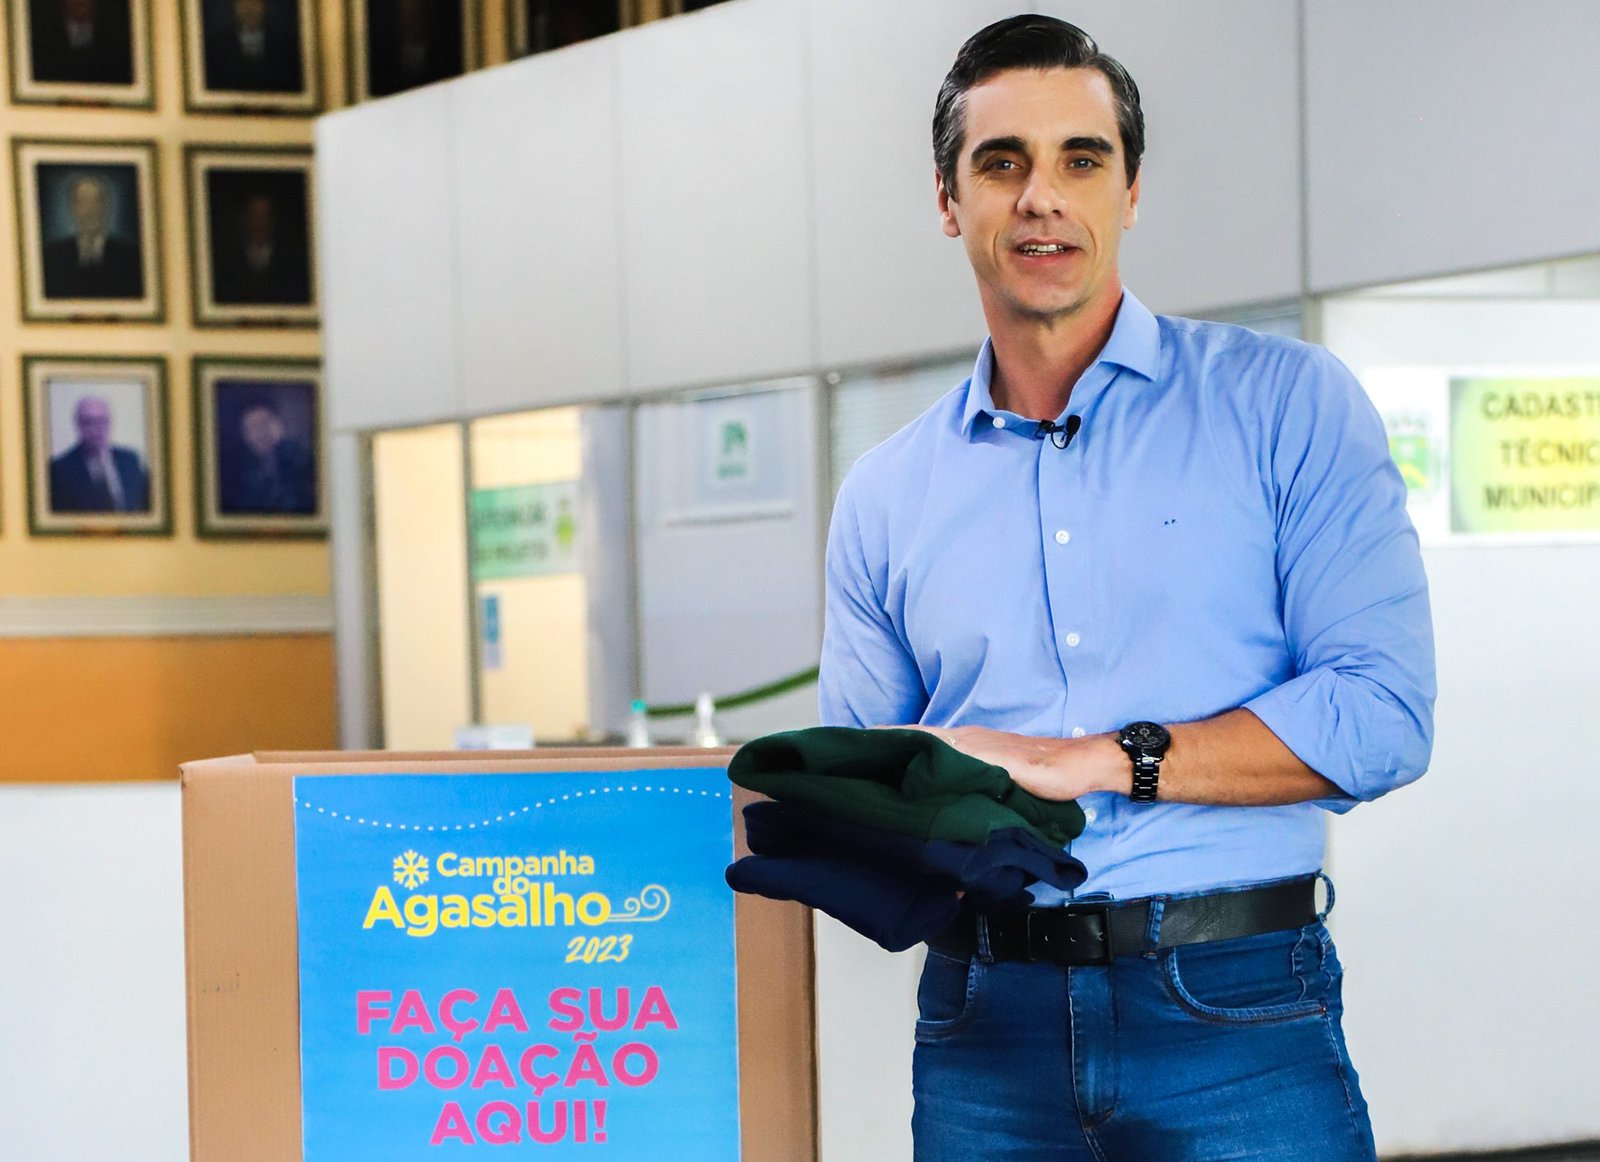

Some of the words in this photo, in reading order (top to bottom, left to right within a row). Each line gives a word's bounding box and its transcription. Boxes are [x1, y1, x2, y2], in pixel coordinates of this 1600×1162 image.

[1480, 391, 1600, 420] CADAST
[436, 850, 595, 879] Campanha
[493, 872, 531, 896] do
[362, 882, 612, 937] Agasalho
[565, 934, 634, 964] 2023
[356, 988, 529, 1042] FAÇA
[548, 986, 679, 1032] SUA
[377, 1032, 660, 1097] DOAÇÃO
[430, 1100, 608, 1145] AQUI!
